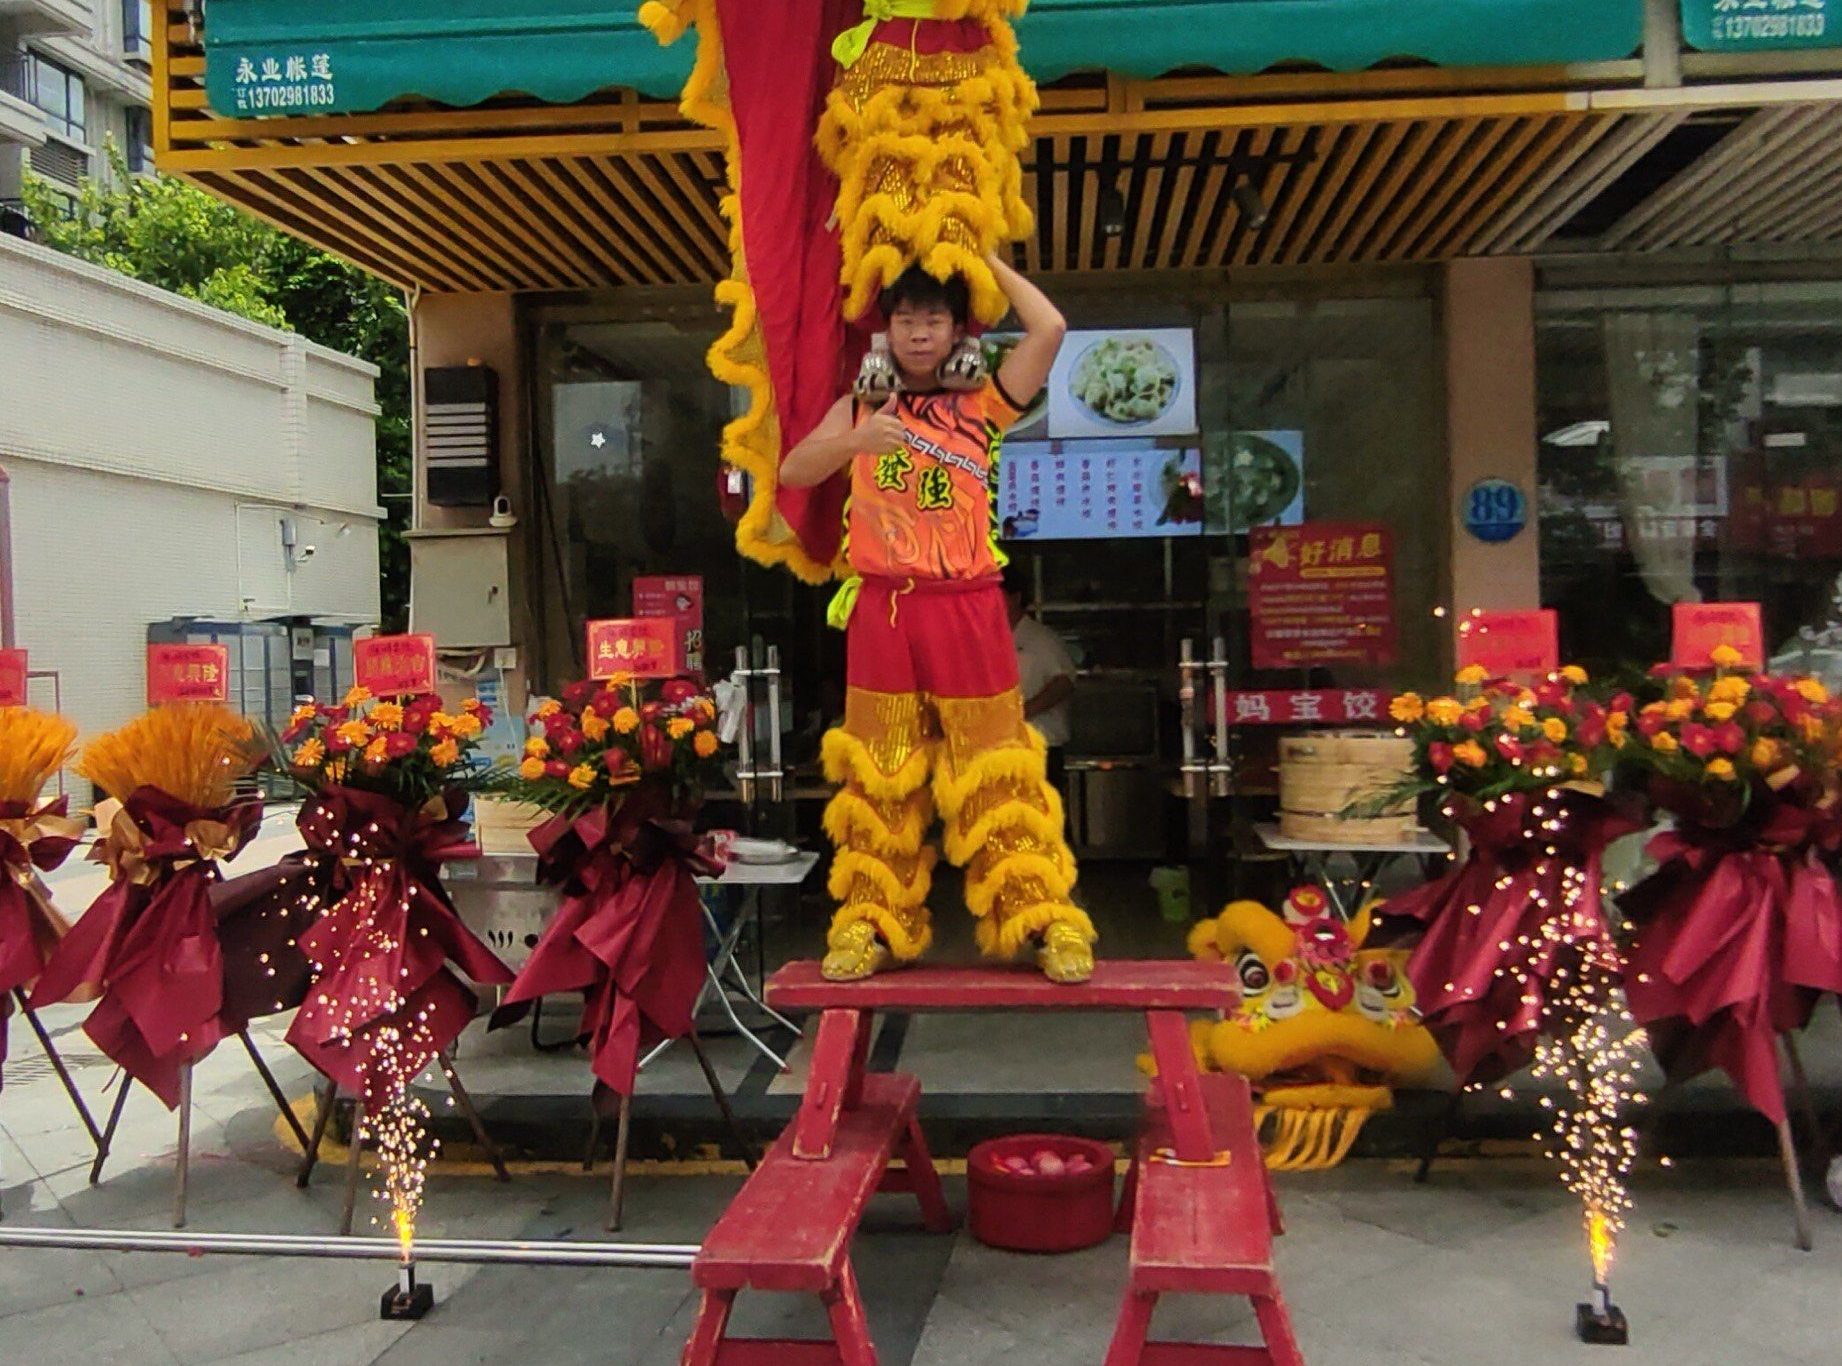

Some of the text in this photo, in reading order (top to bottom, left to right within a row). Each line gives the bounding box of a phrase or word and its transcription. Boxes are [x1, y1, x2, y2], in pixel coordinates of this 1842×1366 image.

[248, 83, 334, 109] 13702981833
[1471, 485, 1517, 523] 89
[1235, 690, 1378, 722] 妈宝饺
